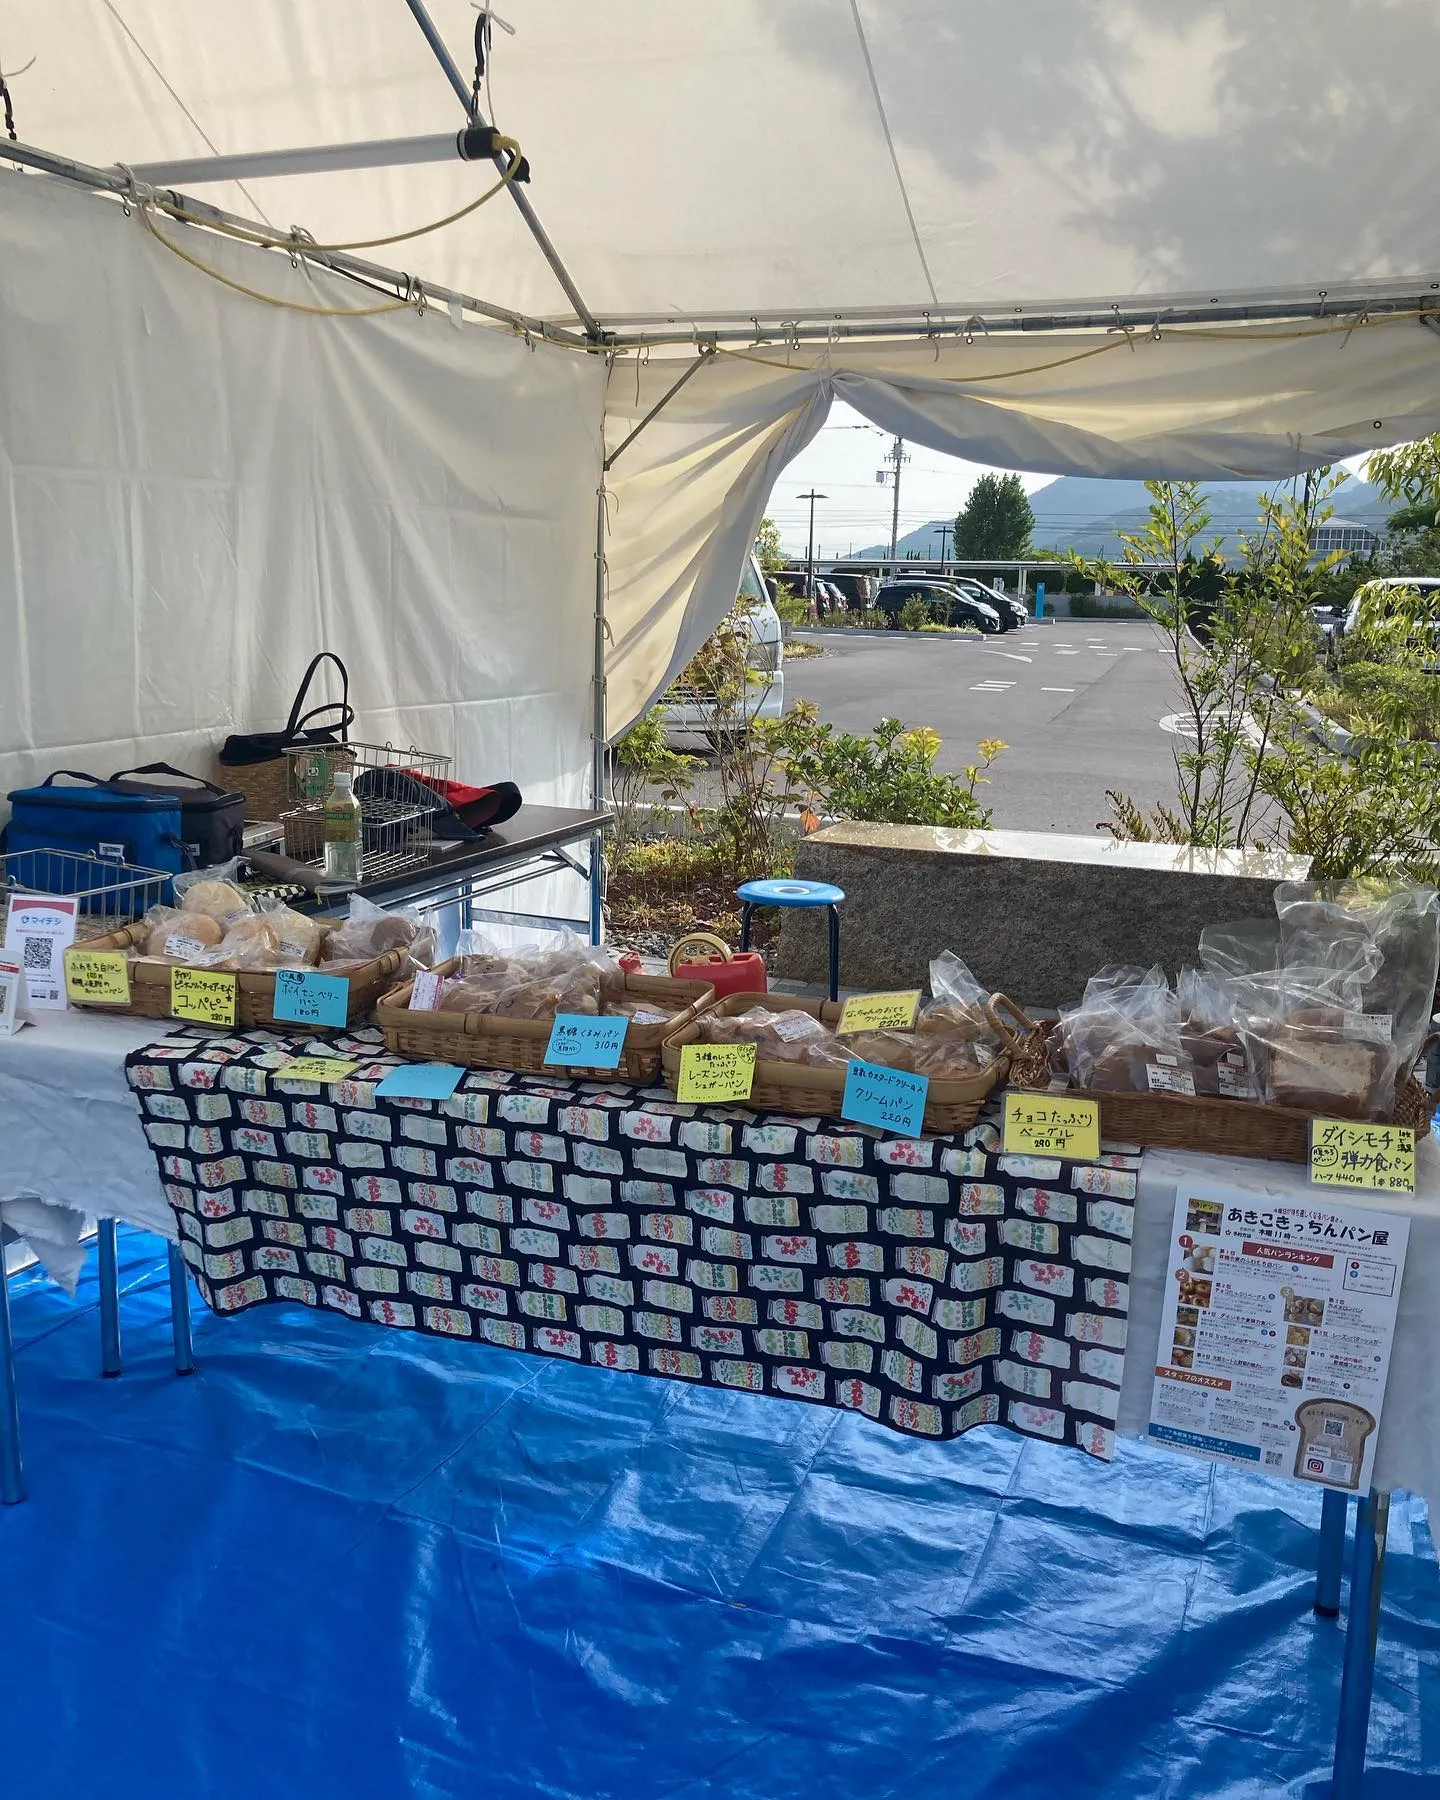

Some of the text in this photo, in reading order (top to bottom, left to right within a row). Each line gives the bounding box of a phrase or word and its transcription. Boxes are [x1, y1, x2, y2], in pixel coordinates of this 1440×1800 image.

[178, 995, 229, 1010] コッペピー
[878, 1019, 908, 1028] 220円
[594, 1041, 619, 1050] 310円
[689, 1070, 743, 1080] レーズンバター
[695, 1080, 744, 1089] シュガーパン
[855, 1087, 914, 1110] クリームパン
[880, 1111, 911, 1127] 220円
[1011, 1107, 1093, 1127] チョコたっぷり
[1020, 1127, 1075, 1138] ベーグル
[1322, 1126, 1394, 1150] ダイシモチ
[1341, 1151, 1413, 1173] 弾力食パン
[1335, 1173, 1363, 1184] 440円
[1389, 1176, 1414, 1193] 880円
[1227, 1208, 1390, 1246] あきこきっちんパン屋
